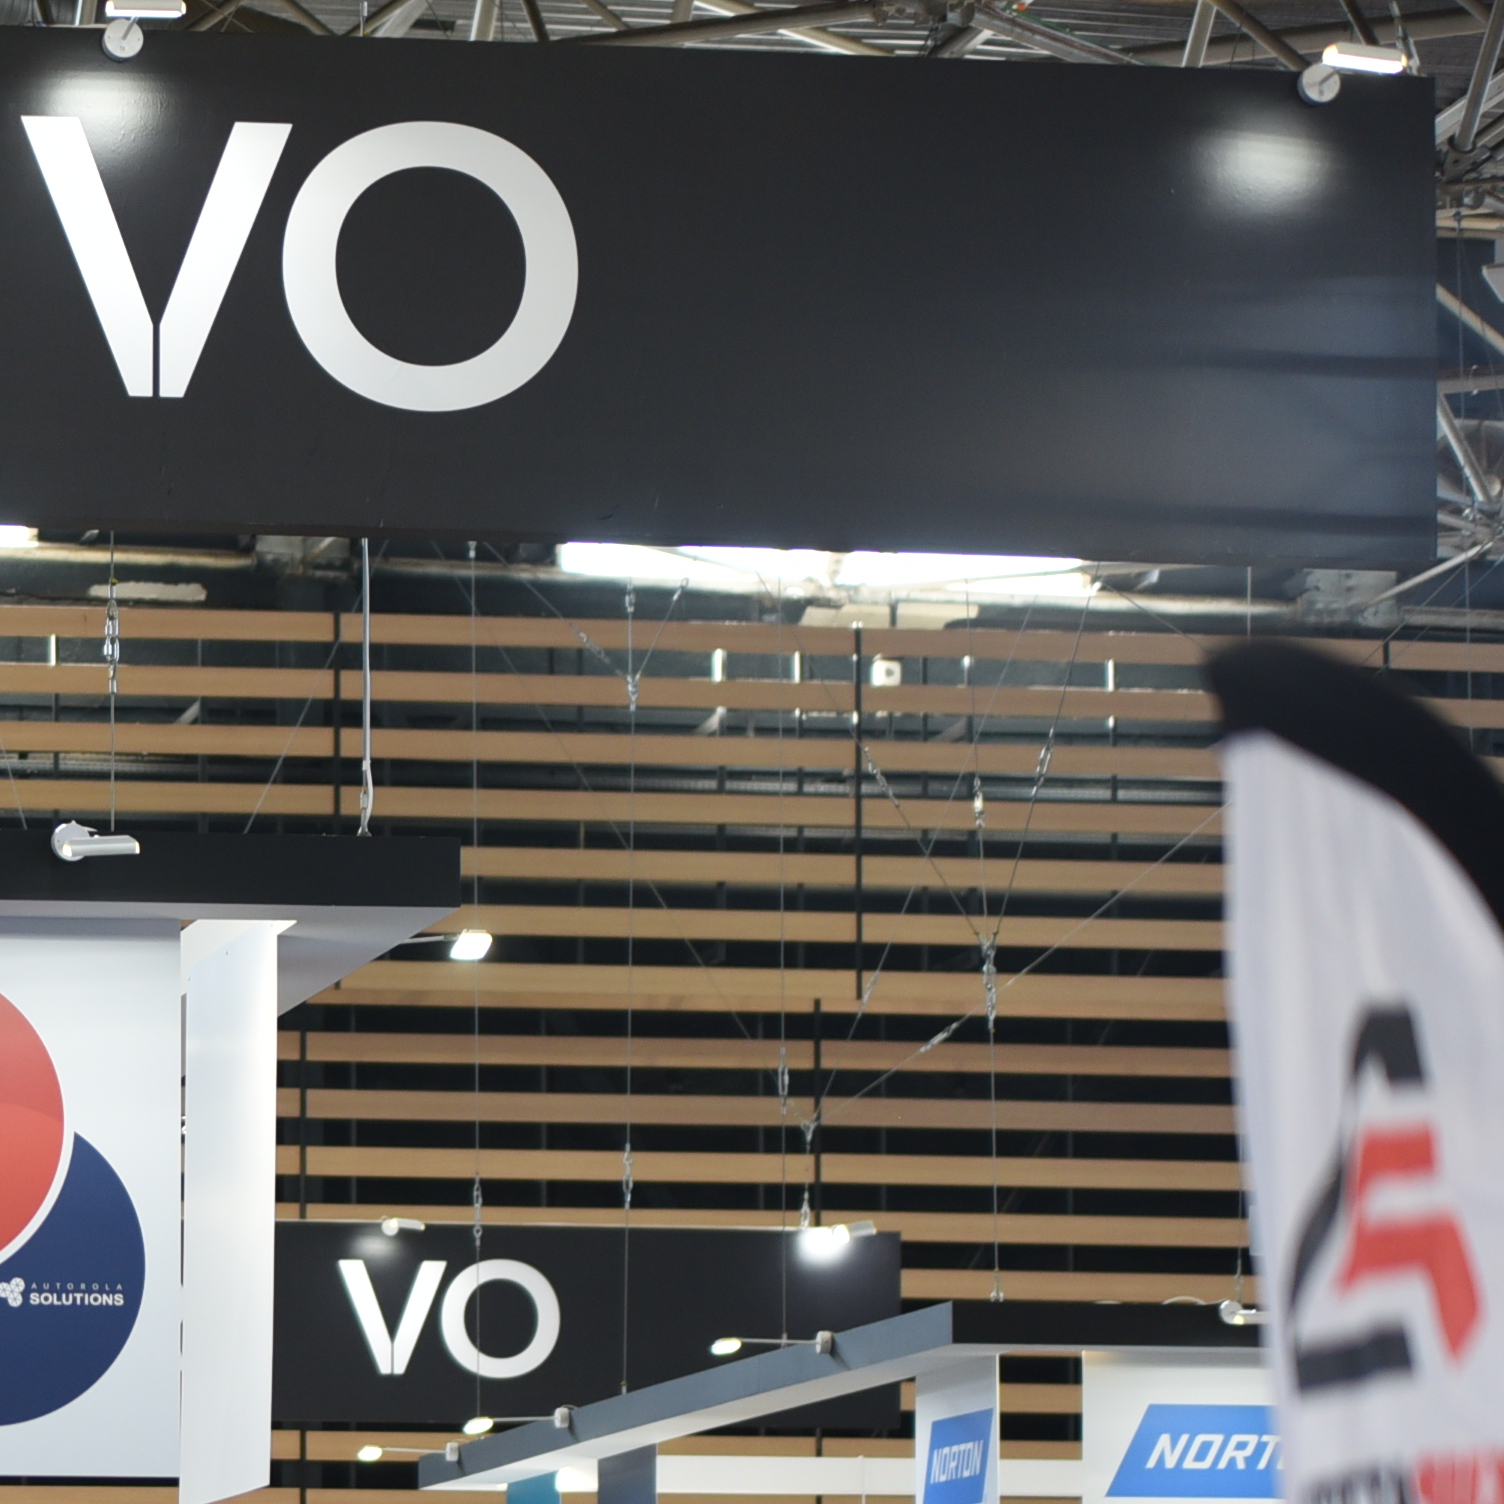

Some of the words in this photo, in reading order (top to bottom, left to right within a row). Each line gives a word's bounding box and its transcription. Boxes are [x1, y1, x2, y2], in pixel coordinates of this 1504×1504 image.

[20, 114, 579, 412] VO
[29, 1292, 125, 1307] SOLUTIONS
[30, 1282, 123, 1291] AUTOROLA
[338, 1259, 561, 1379] VO
[930, 1439, 984, 1484] NORTON
[1145, 1432, 1284, 1470] NORT
